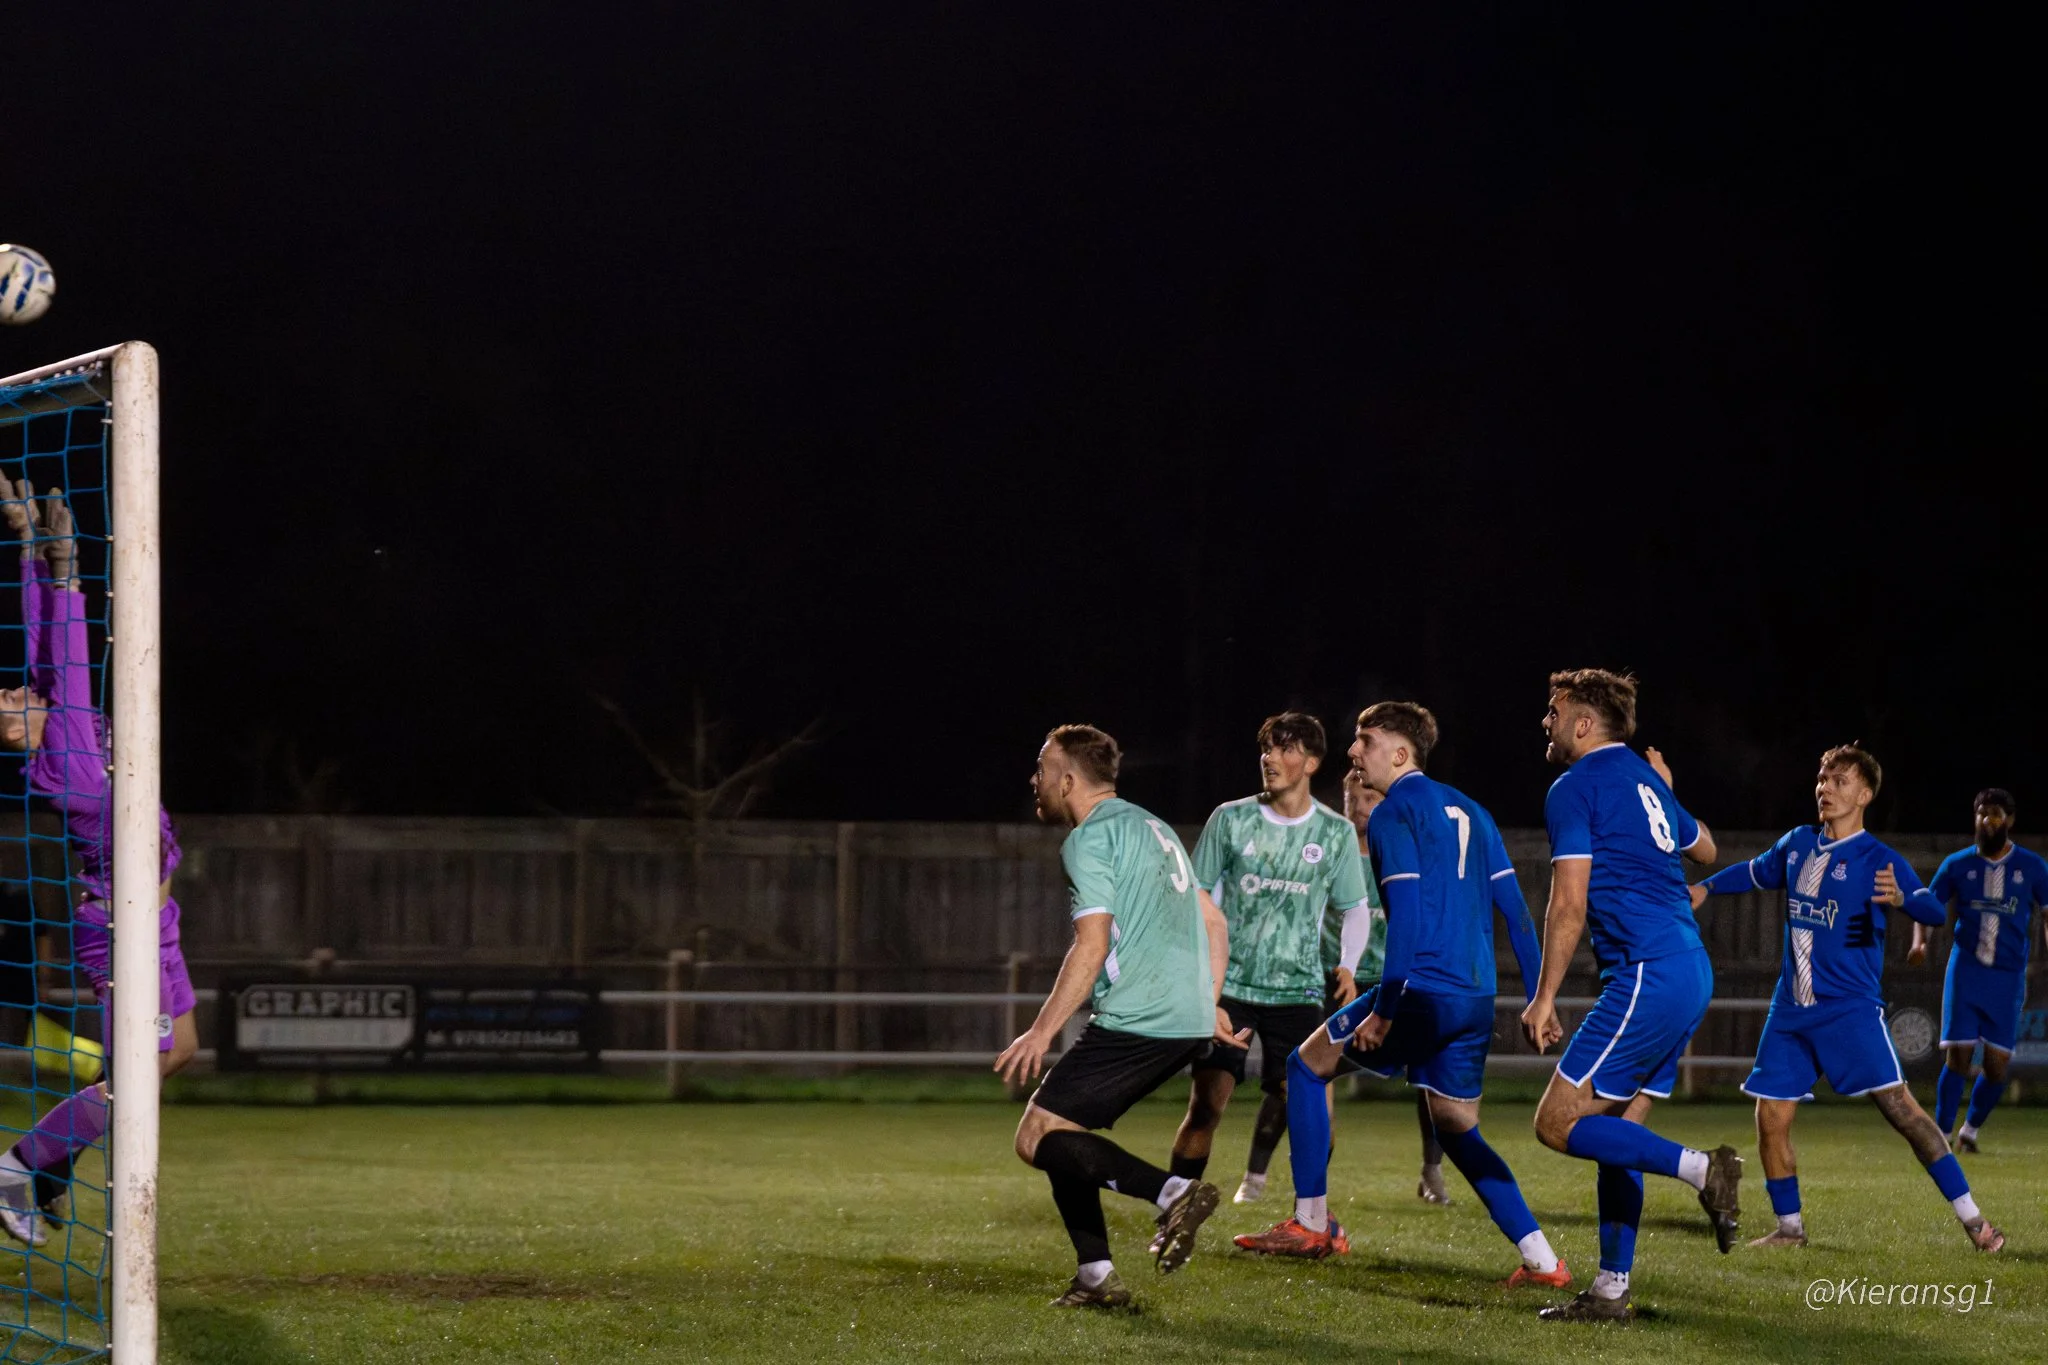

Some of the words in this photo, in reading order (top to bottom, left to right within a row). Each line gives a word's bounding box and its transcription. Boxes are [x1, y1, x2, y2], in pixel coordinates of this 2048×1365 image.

[1444, 805, 1470, 880] 7
[1637, 783, 1675, 853] 8
[1144, 819, 1189, 893] 5
[1260, 878, 1311, 895] PIRTEK
[247, 990, 402, 1016] GRAPHIC
